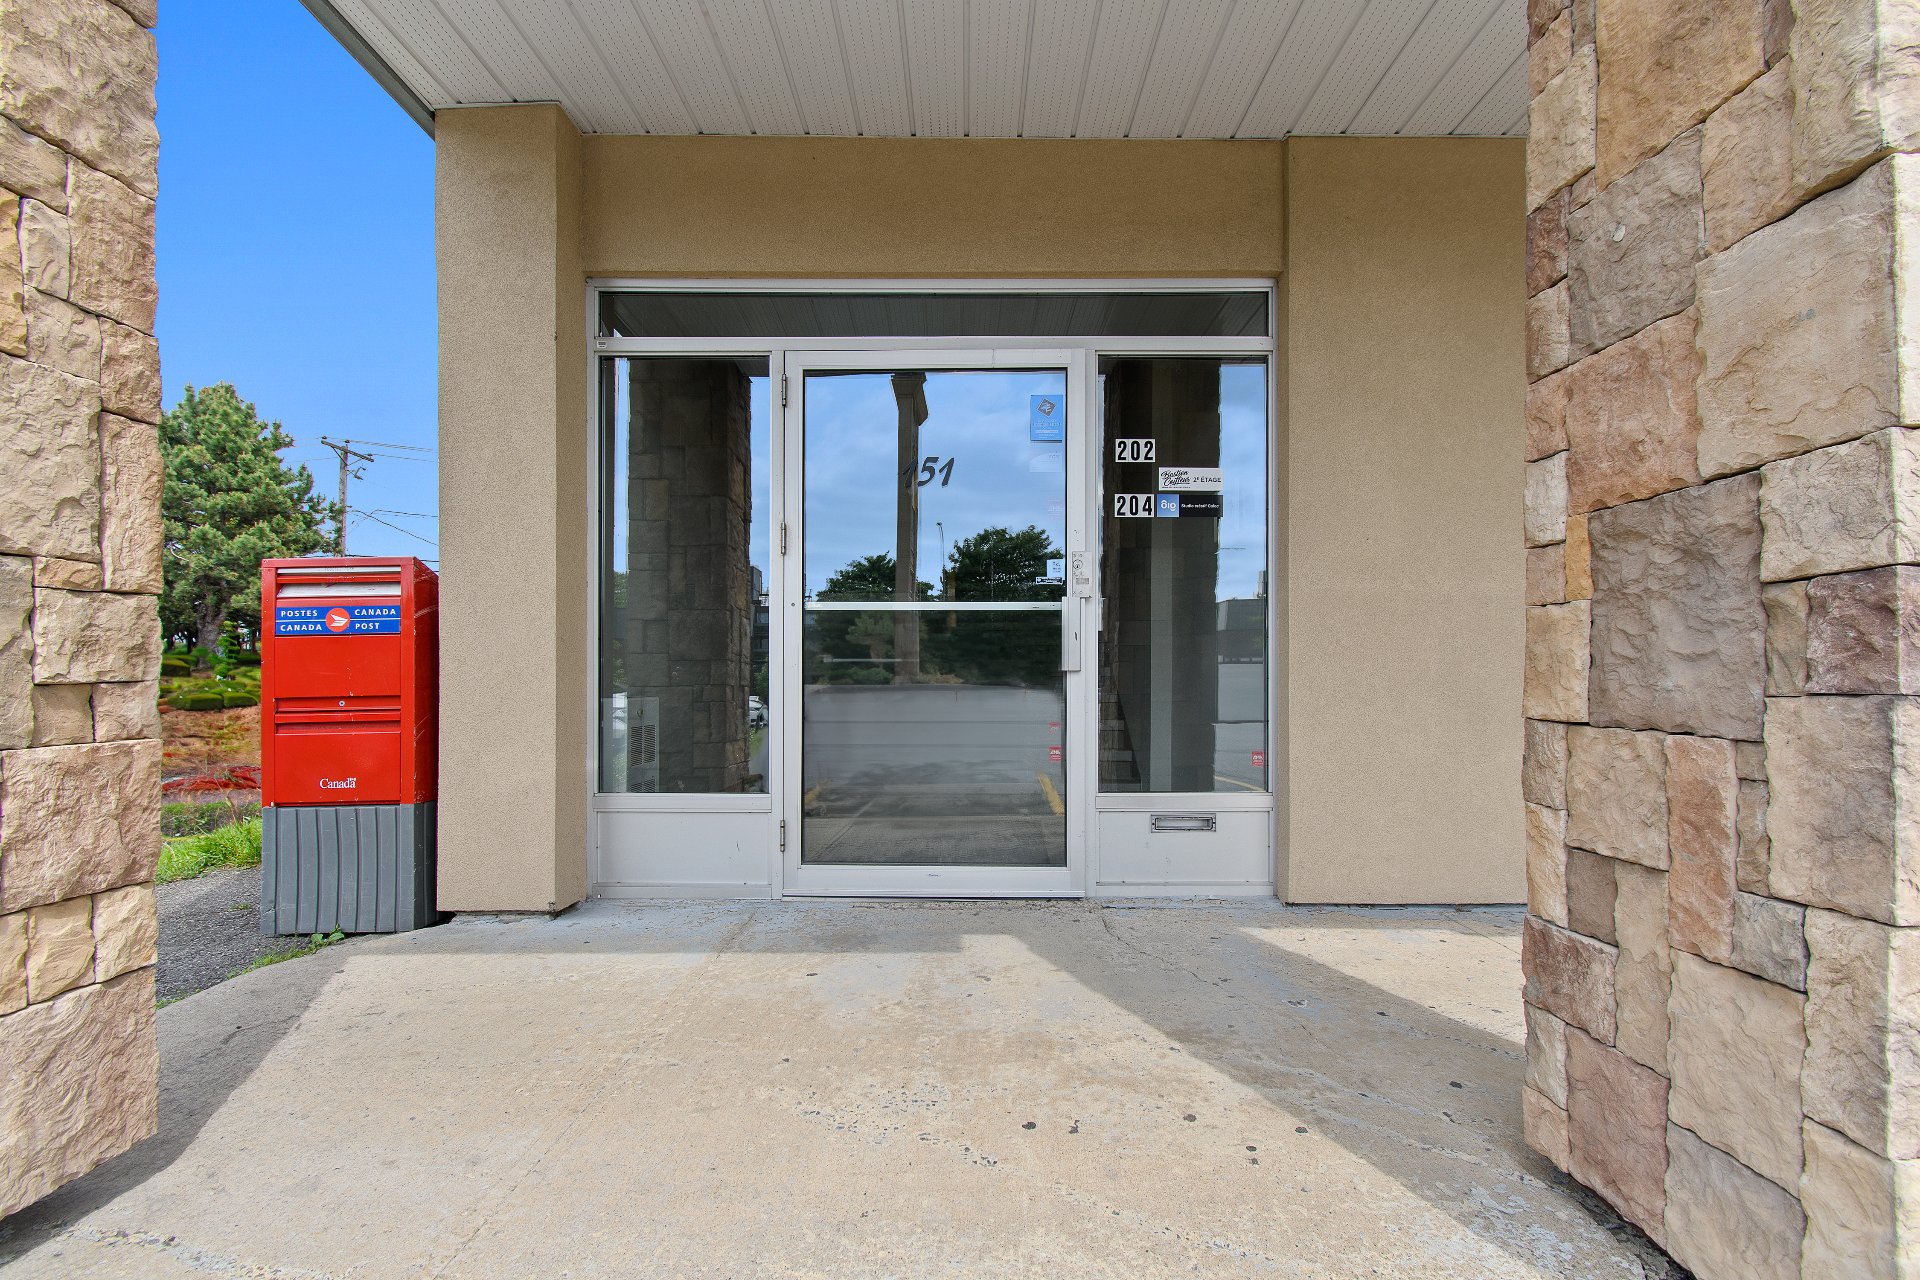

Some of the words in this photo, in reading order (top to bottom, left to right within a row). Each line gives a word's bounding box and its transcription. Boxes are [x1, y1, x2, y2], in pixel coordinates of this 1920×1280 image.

[1117, 440, 1154, 461] 202
[902, 456, 955, 488] 151
[1200, 475, 1222, 483] ÉTAGE
[1116, 495, 1153, 516] 204
[280, 609, 318, 618] POSTES
[354, 608, 396, 616] CANADA
[280, 623, 322, 632] CANADA
[355, 622, 380, 630] POST
[319, 777, 357, 789] Canada
